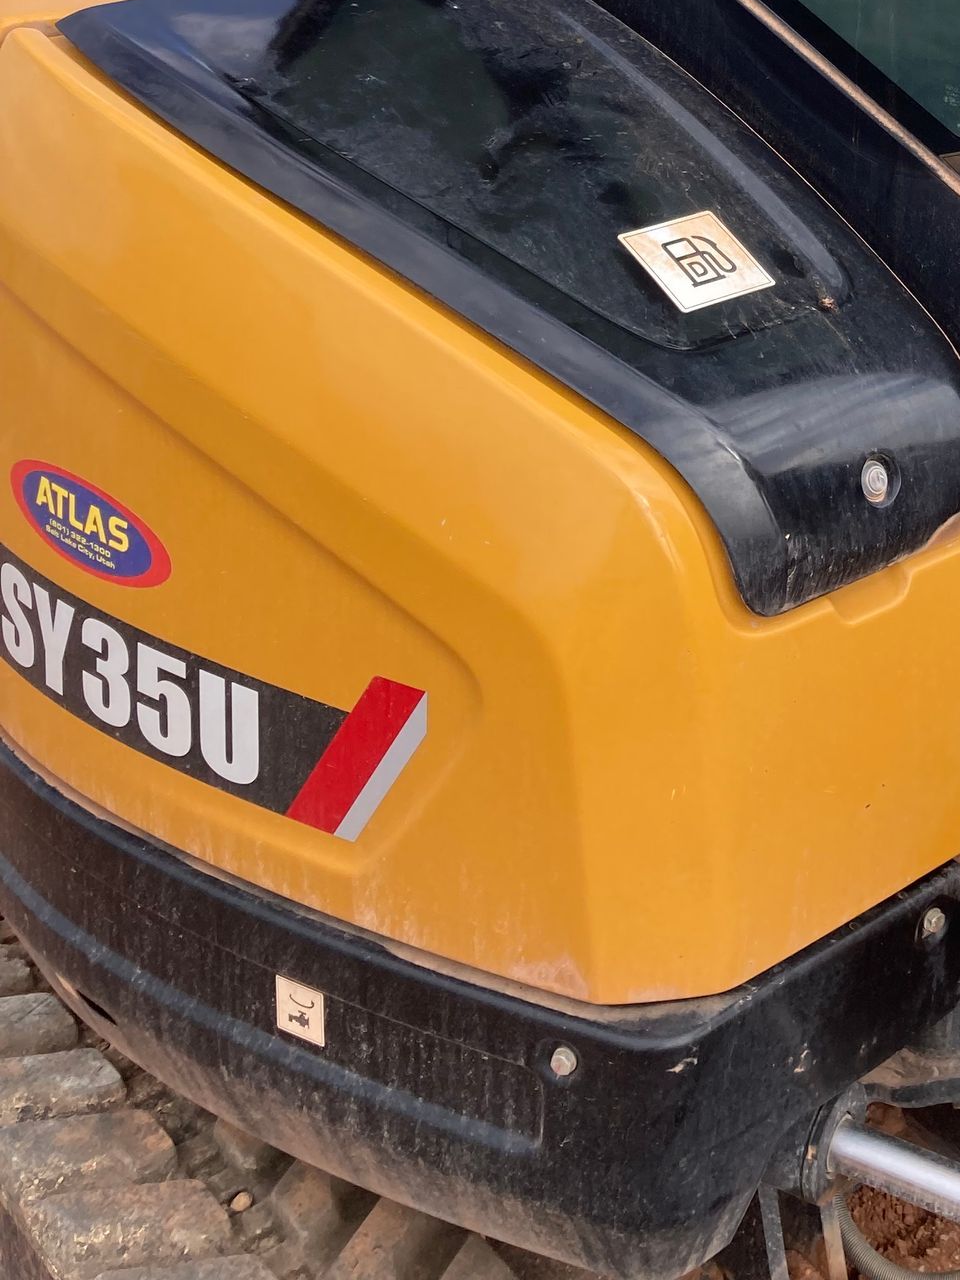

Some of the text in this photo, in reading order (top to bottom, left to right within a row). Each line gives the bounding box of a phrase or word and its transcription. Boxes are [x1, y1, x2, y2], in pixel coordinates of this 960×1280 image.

[36, 475, 129, 552] ATLAS
[50, 518, 111, 557] (801) 322-1300
[60, 533, 77, 549] Lake
[77, 544, 95, 560] City,
[95, 554, 115, 570] Utah
[0, 562, 260, 785] SY35U
